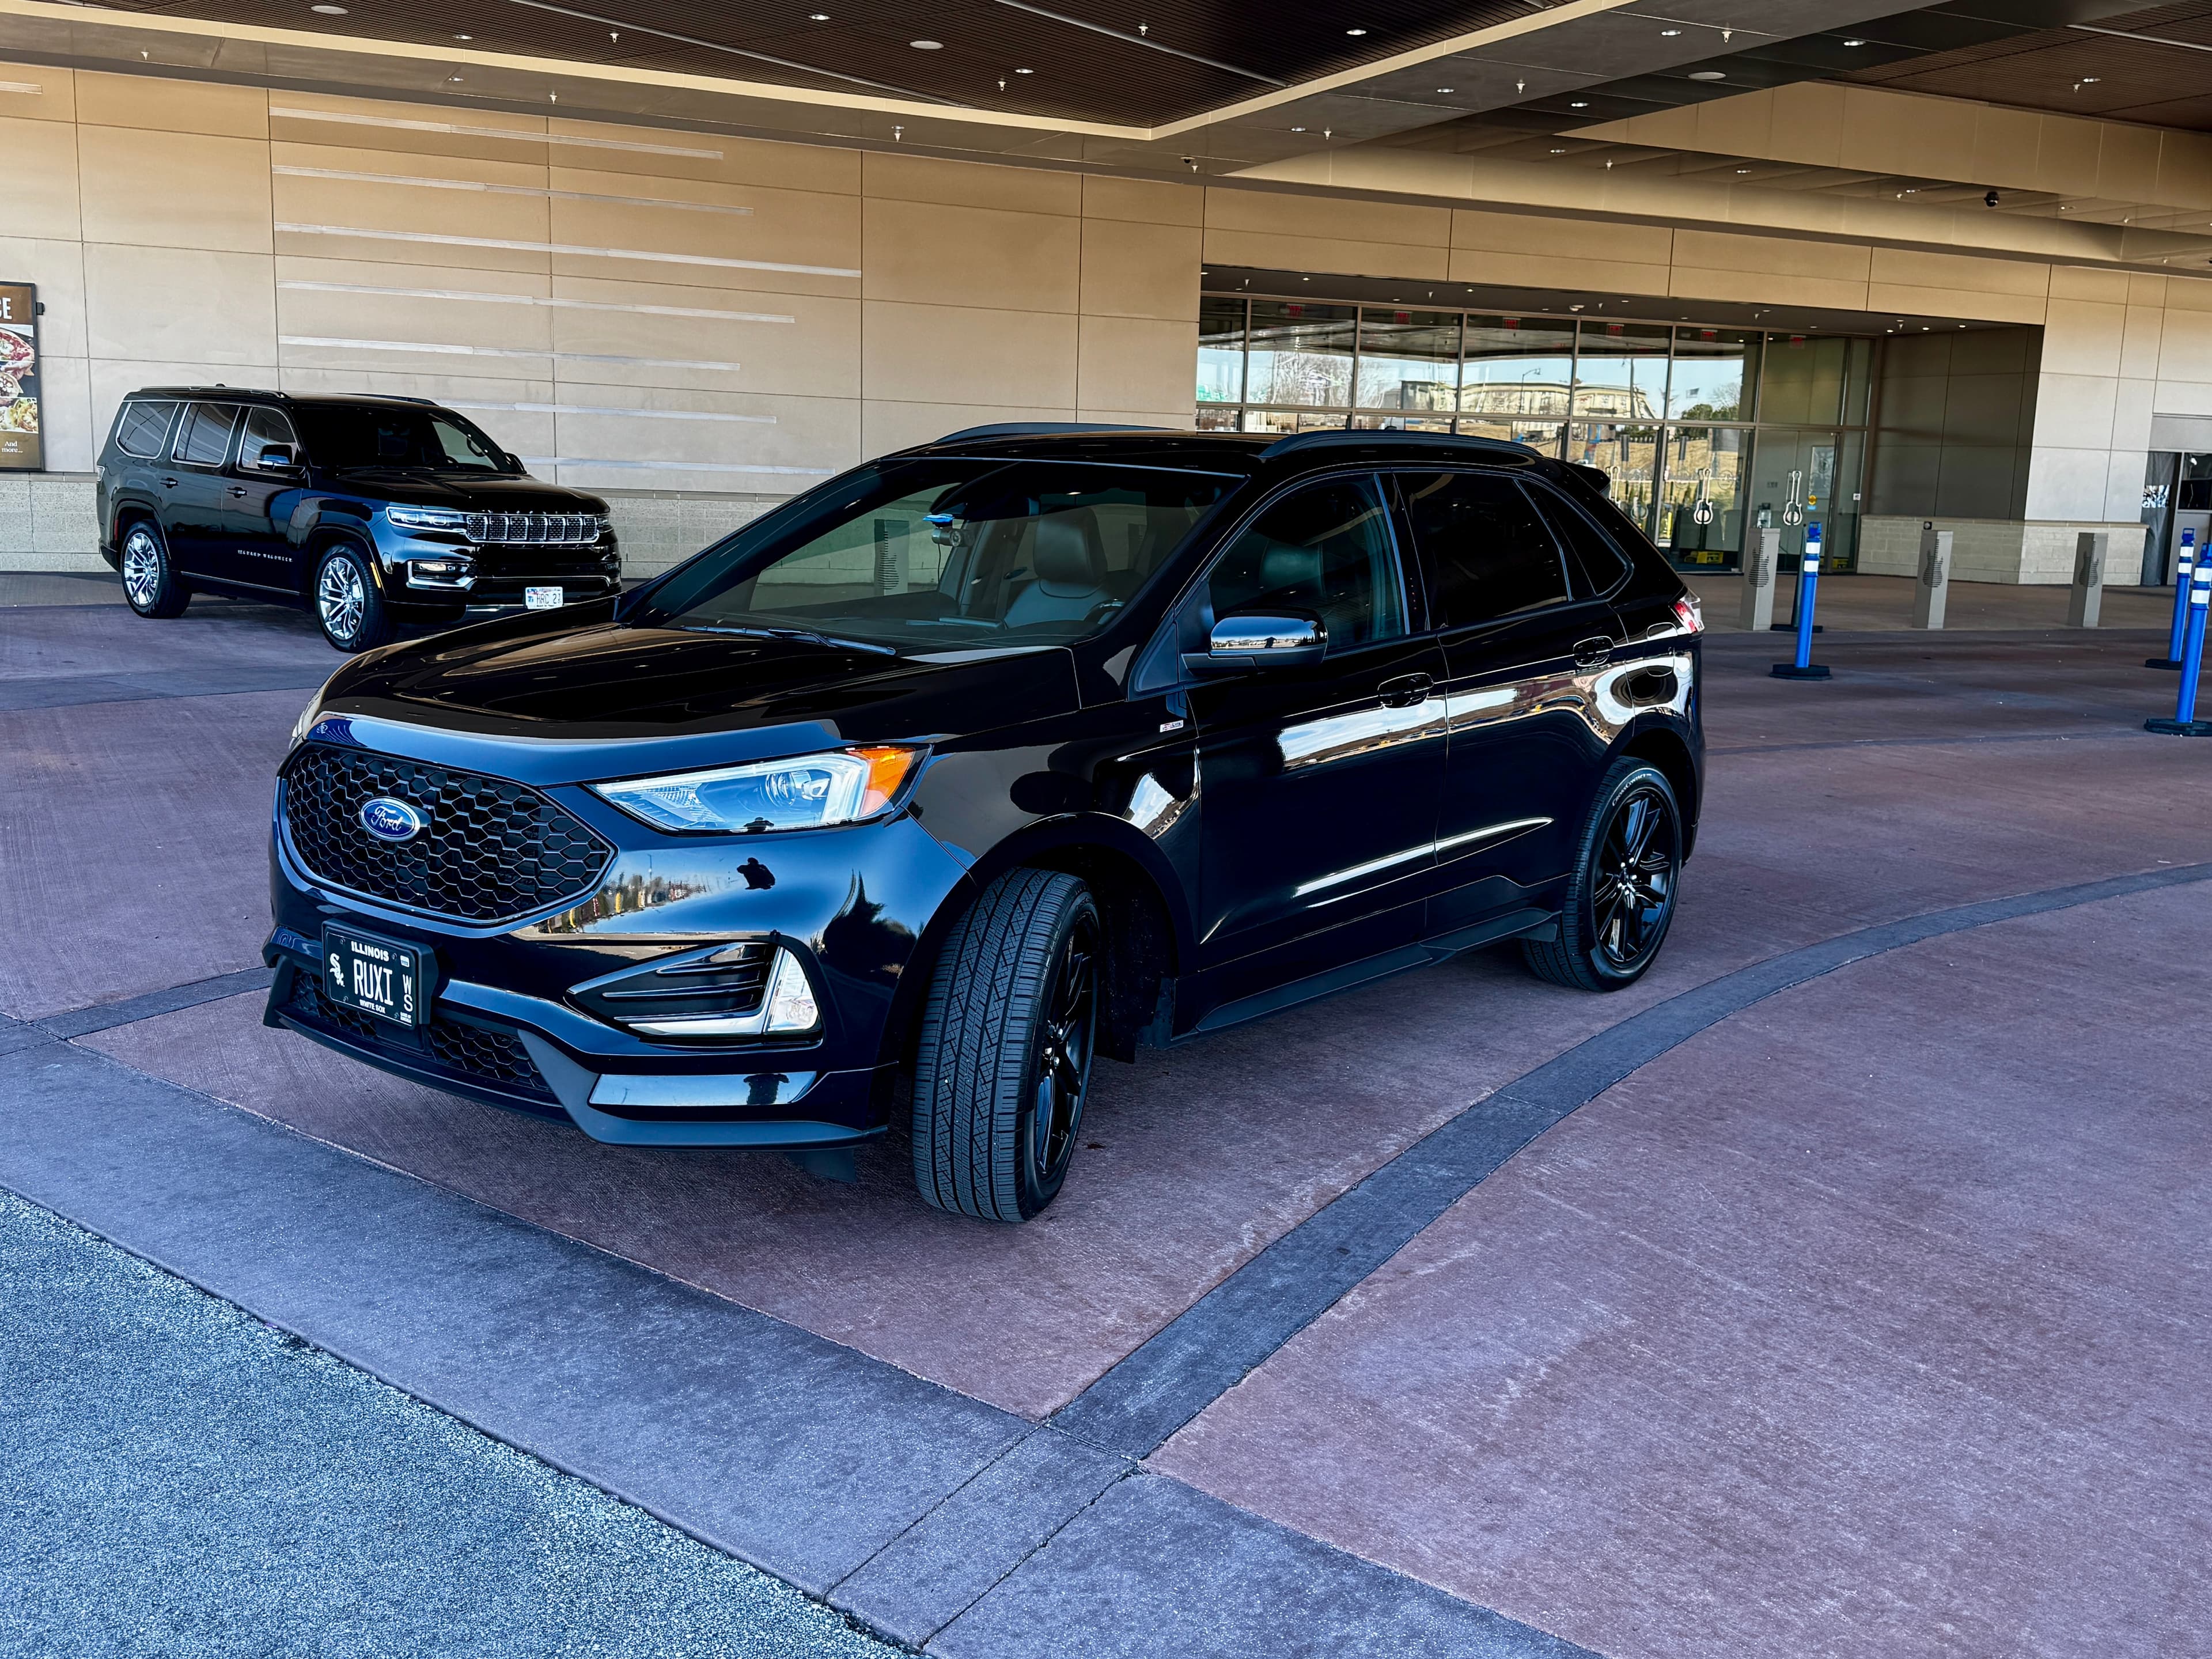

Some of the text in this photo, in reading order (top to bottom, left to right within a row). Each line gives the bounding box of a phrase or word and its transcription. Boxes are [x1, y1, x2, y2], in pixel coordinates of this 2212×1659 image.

[0, 297, 12, 320] E
[371, 806, 403, 831] Ford
[351, 941, 389, 962] ILLINOIS
[353, 959, 393, 1006] RUXI
[359, 999, 386, 1014] WHITE SOX
